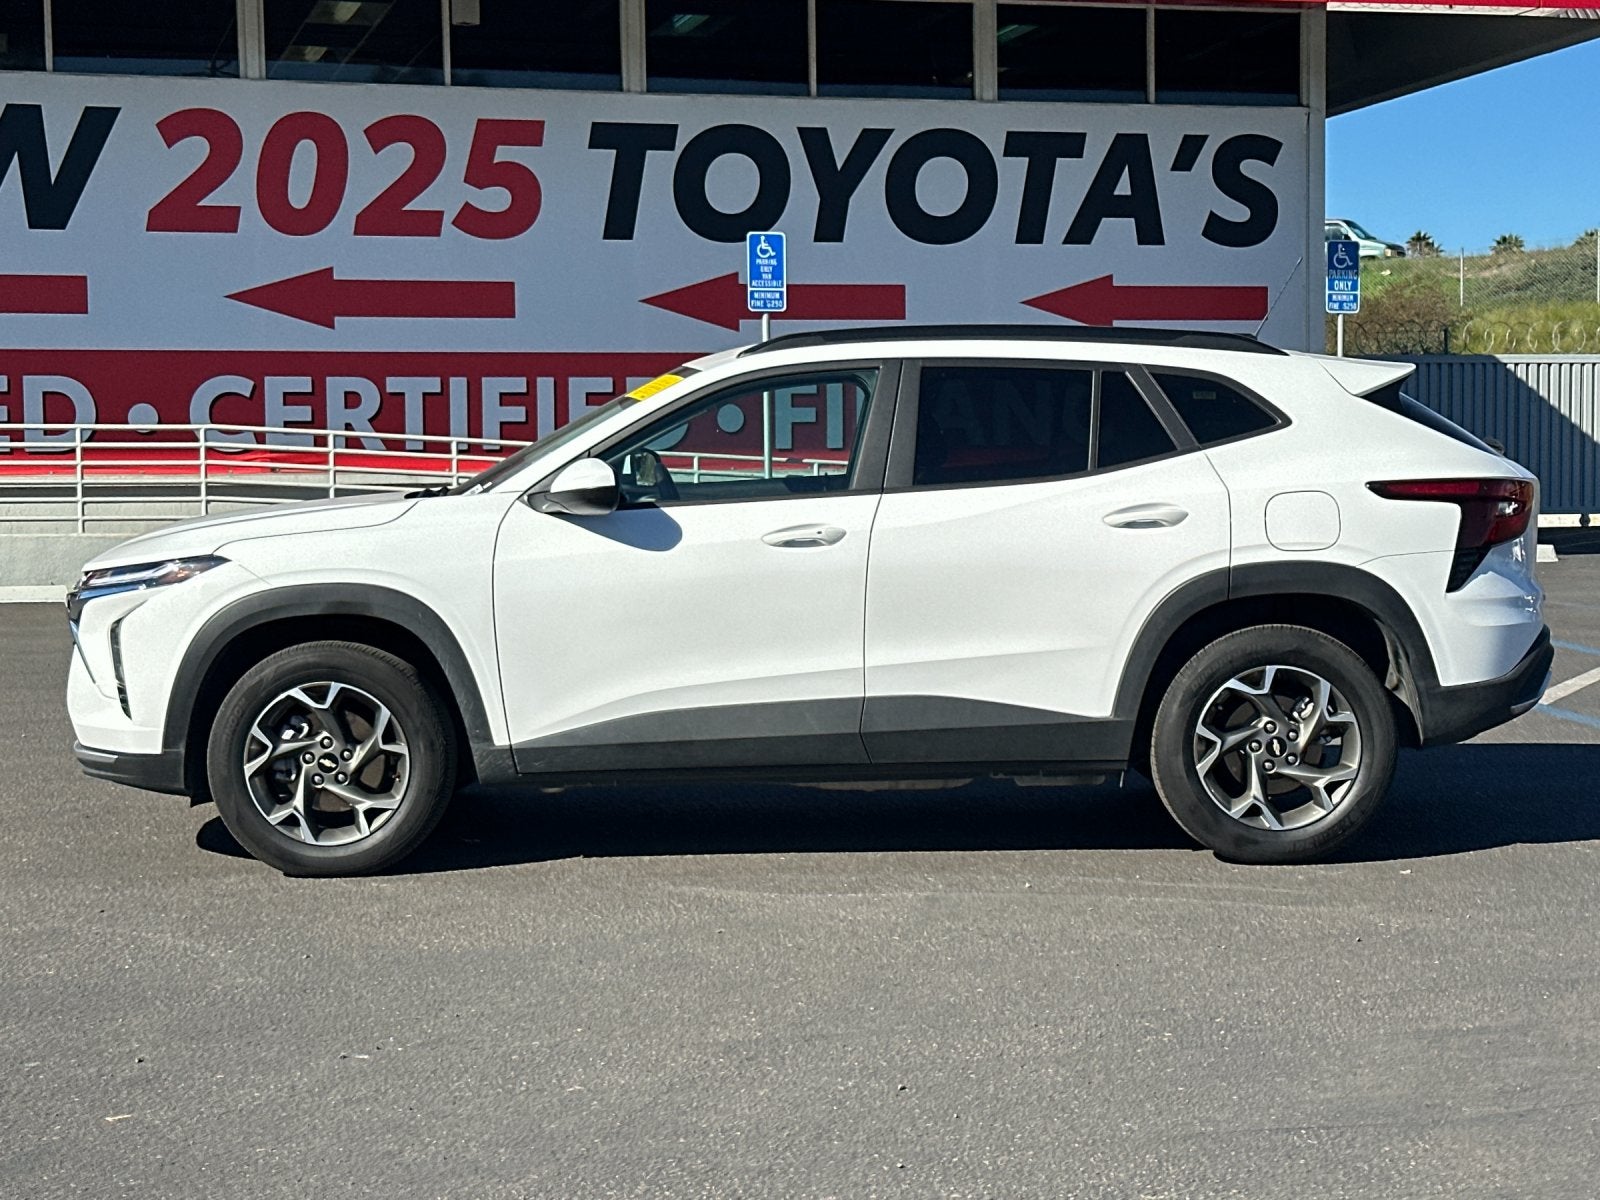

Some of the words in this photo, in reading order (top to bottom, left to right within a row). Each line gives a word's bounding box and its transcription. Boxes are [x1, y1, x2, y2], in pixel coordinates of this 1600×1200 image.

[146, 108, 546, 240] 2025
[588, 121, 1284, 247] TOYOTA'S
[1328, 270, 1358, 280] PARKING
[1334, 280, 1352, 290] ONLY
